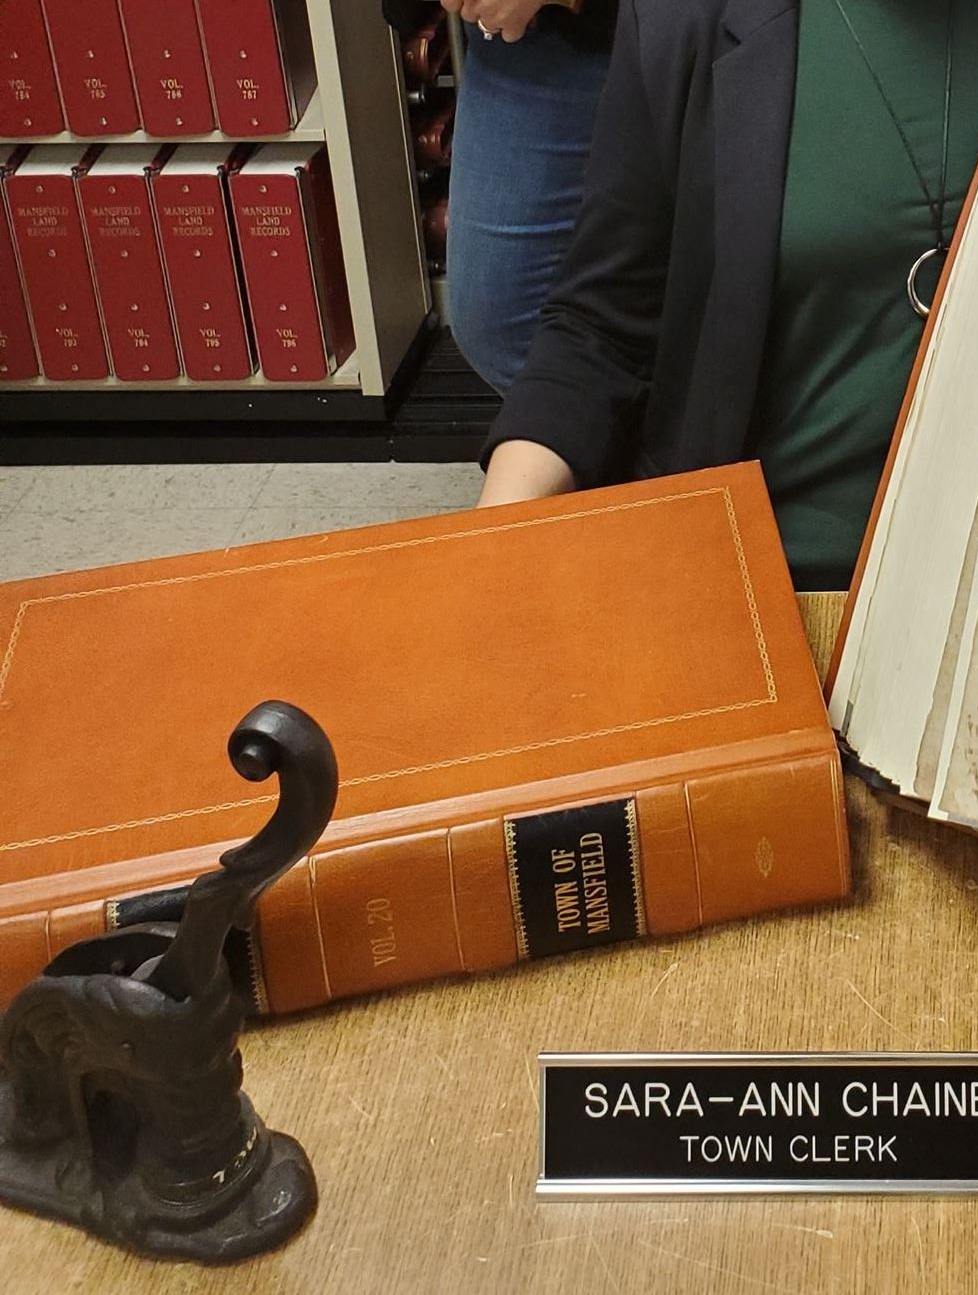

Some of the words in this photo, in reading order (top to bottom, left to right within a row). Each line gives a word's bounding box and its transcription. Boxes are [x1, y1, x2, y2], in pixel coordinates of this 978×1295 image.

[84, 79, 107, 89] VOL.
[160, 79, 184, 89] VOL.
[236, 79, 260, 89] VOL.
[242, 89, 258, 99] 787
[18, 205, 69, 217] MANSFIELD
[91, 205, 142, 217] MANSFIELD
[163, 205, 214, 217] MANSFIELD
[241, 205, 292, 217] MANSFIELD
[32, 217, 58, 227] LAND
[105, 217, 130, 227] LAND
[178, 217, 204, 227] LAND
[256, 217, 280, 227] LAND
[27, 226, 68, 237] RECORDS
[98, 226, 140, 237] RECORDS
[172, 226, 214, 237] RECORDS
[250, 226, 291, 237] RECORDS
[56, 327, 78, 339] VOL.
[128, 327, 150, 339] VOL.
[200, 327, 222, 339] VOL.
[276, 327, 298, 339] VOL.
[551, 849, 576, 877] OF
[579, 831, 611, 935] MANSFIELD
[366, 897, 392, 925] 20
[554, 881, 583, 934] TOWN
[369, 925, 398, 968] VOL.
[584, 1081, 821, 1119] SARA-ANN
[679, 1135, 774, 1163] TOWN
[789, 1134, 899, 1163] CLERK
